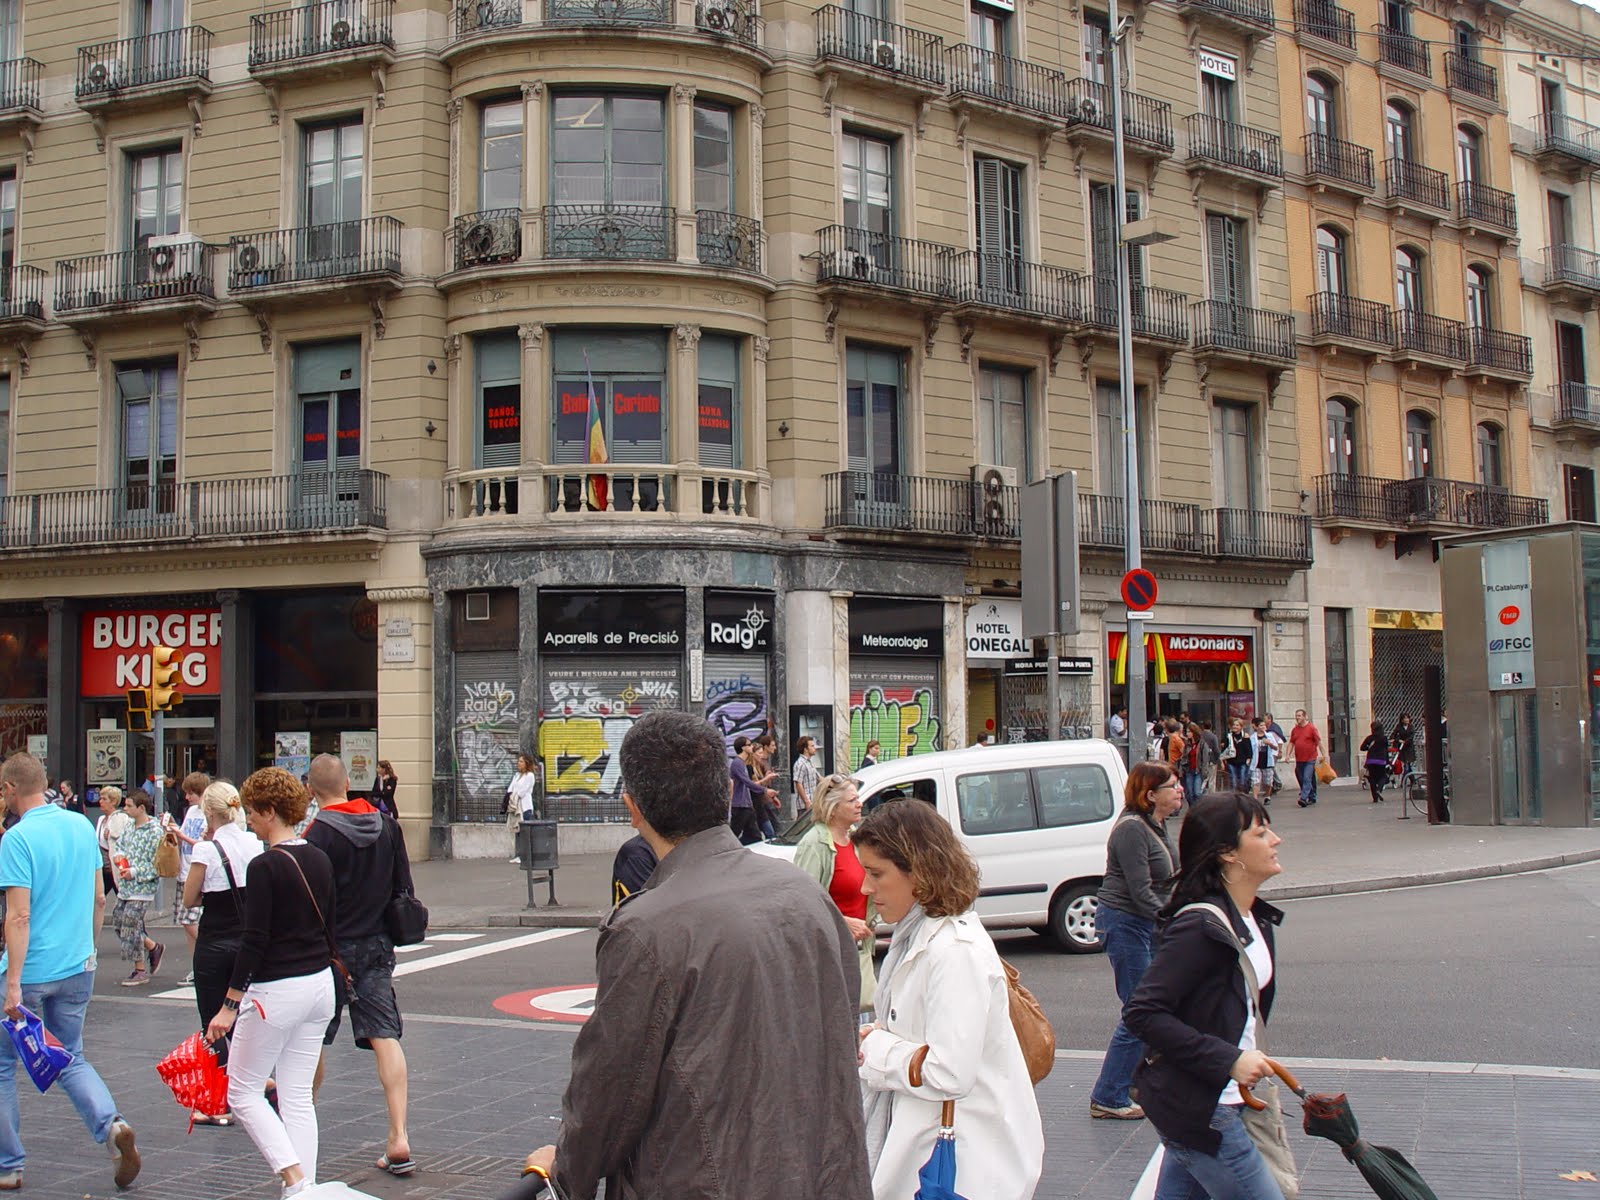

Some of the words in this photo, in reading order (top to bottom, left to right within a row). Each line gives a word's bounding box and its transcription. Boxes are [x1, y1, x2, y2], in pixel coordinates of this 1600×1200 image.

[1200, 55, 1235, 75] HOTEL
[614, 392, 660, 415] Corinto
[488, 417, 519, 429] TURCOS
[976, 623, 1011, 634] HOTEL
[544, 631, 599, 647] Aparells
[603, 632, 623, 644] de
[628, 630, 680, 645] Precisió
[862, 634, 929, 650] Meteorologia
[1169, 636, 1244, 651] McDonald's
[1505, 637, 1531, 649] FGC
[115, 652, 207, 688] KIG
[640, 669, 677, 678] PRECISIÓ
